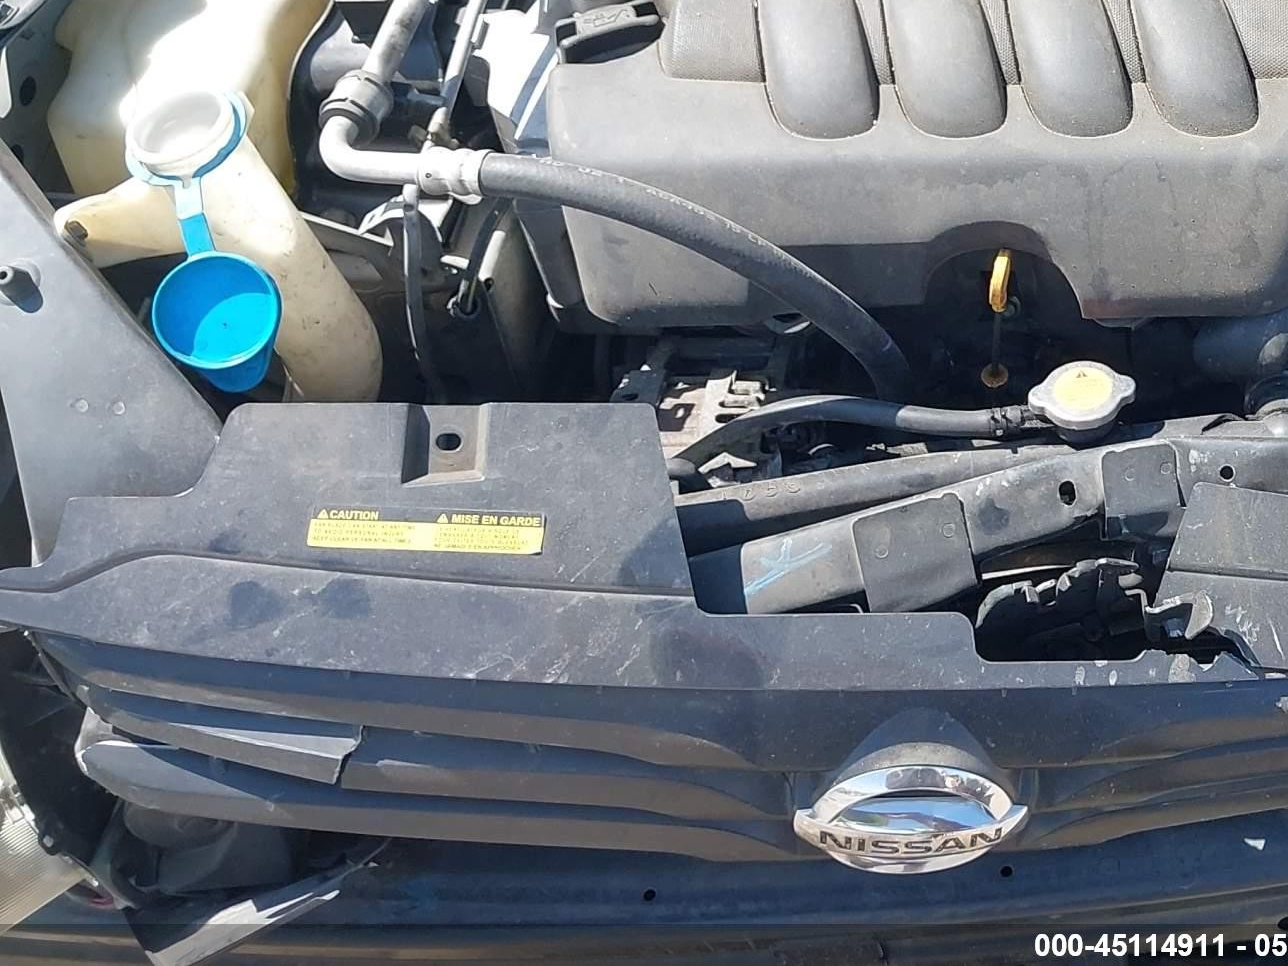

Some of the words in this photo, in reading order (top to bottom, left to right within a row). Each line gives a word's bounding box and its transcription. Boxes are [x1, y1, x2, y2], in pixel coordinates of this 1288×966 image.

[329, 510, 380, 520] CAUTION
[451, 514, 479, 524] MISE
[481, 515, 497, 525] EN
[499, 516, 541, 526] GARDE
[818, 826, 1003, 854] NISSAN
